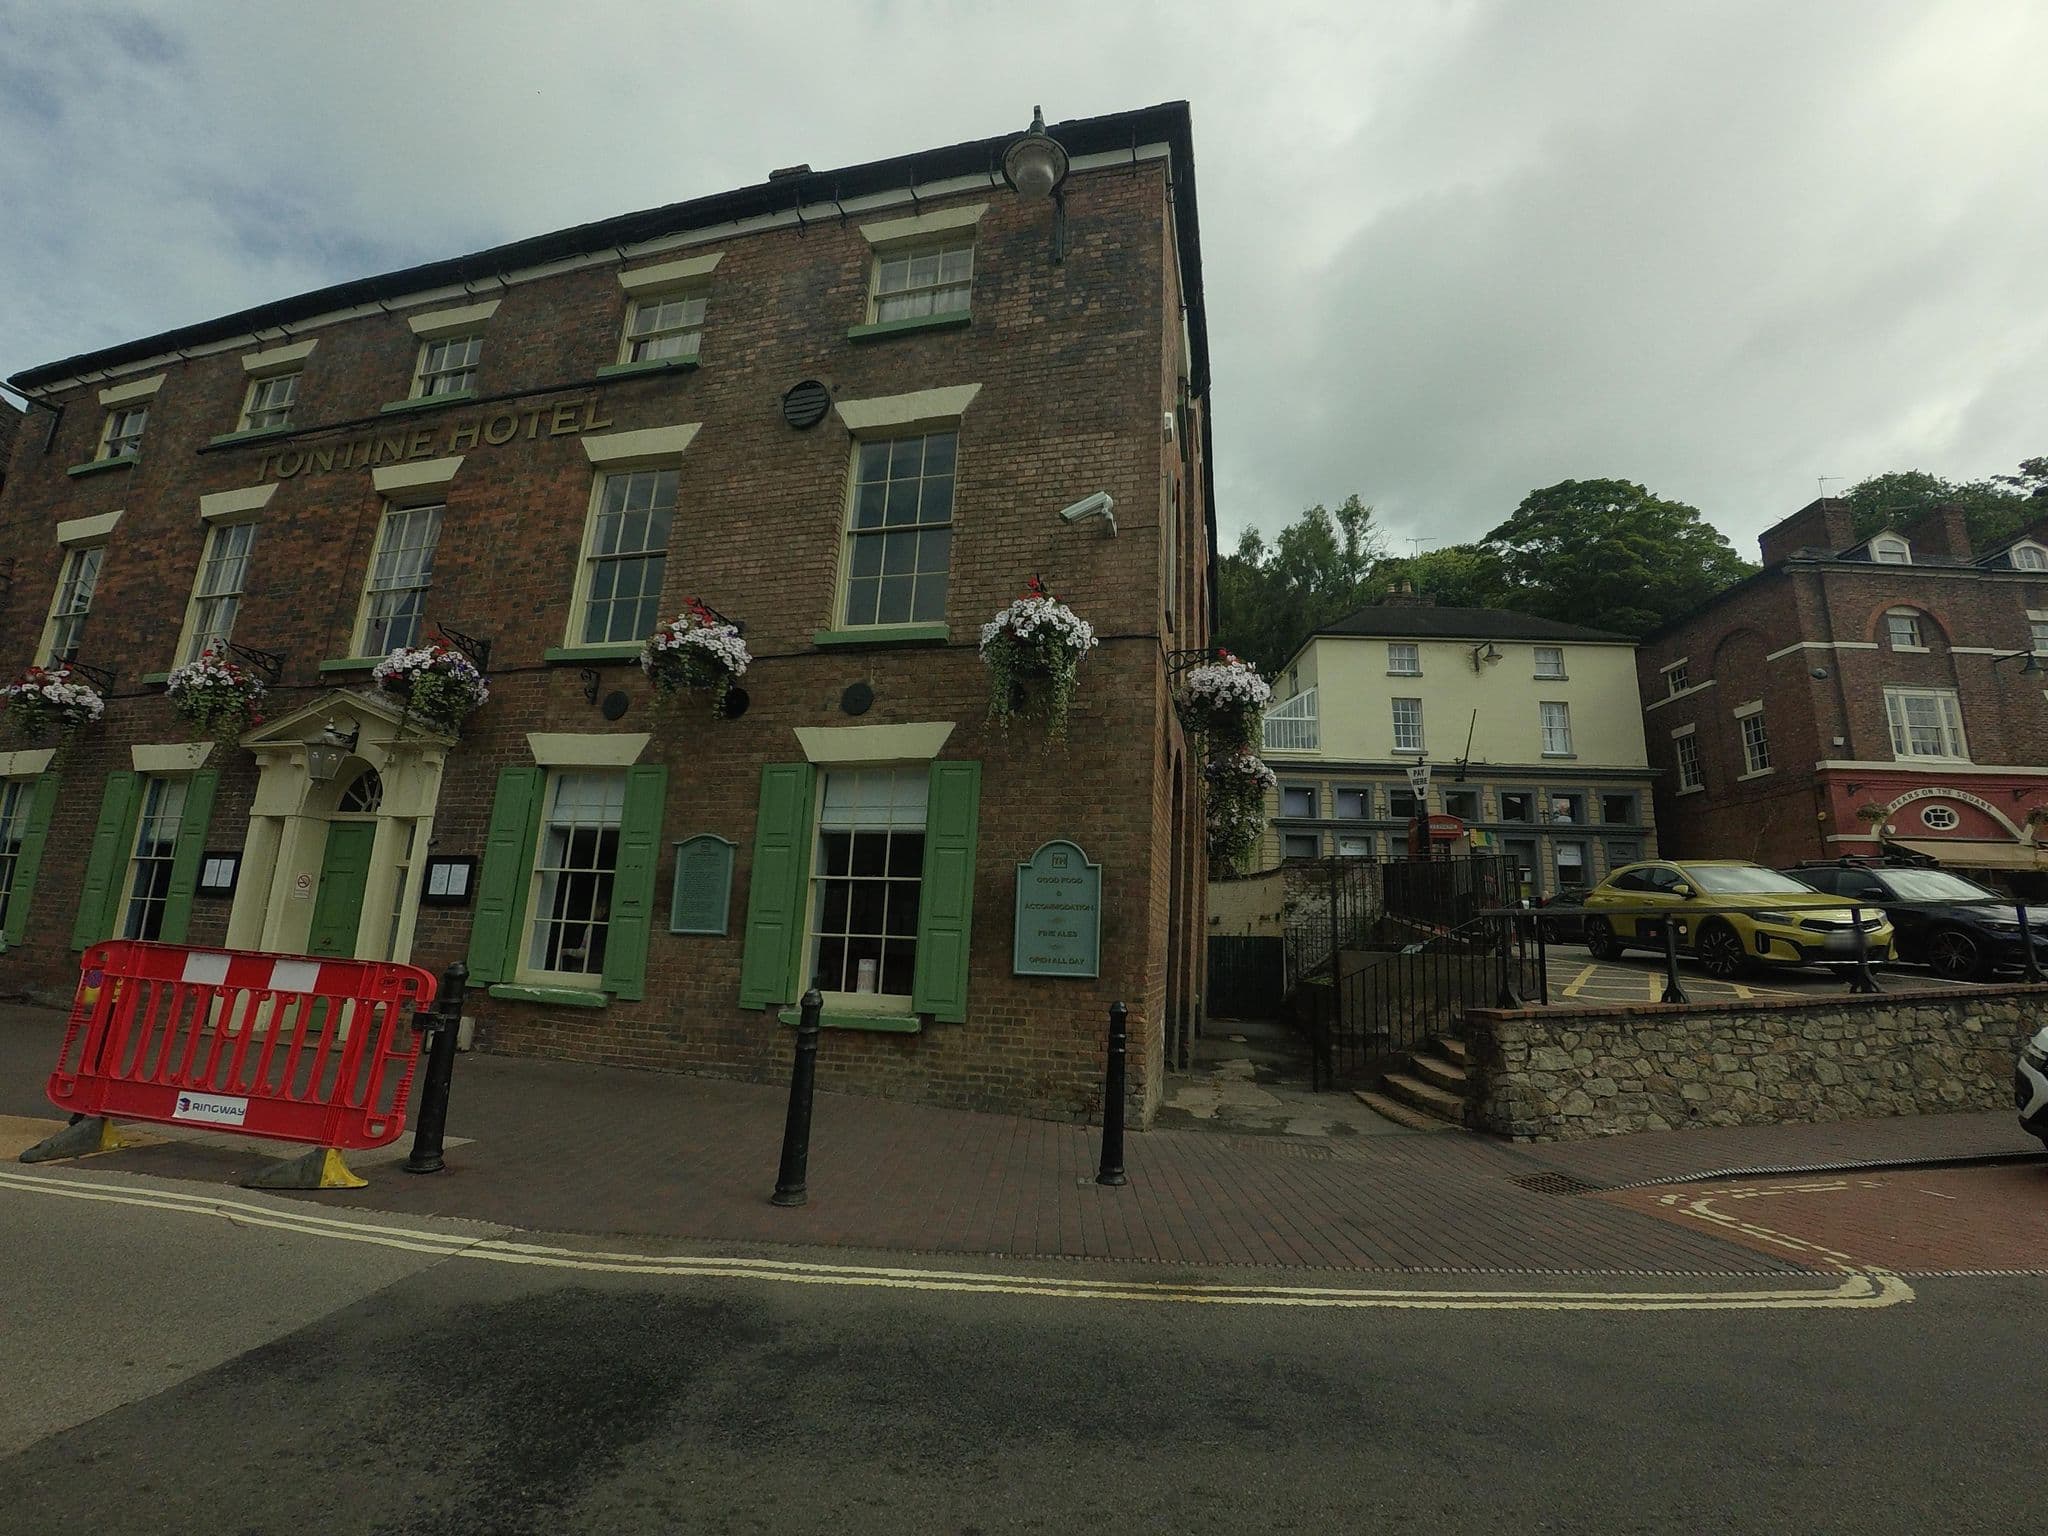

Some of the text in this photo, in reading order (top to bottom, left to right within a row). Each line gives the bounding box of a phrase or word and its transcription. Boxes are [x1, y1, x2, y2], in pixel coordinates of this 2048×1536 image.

[254, 396, 614, 483] TONTINE HOTEL
[1413, 768, 1425, 777] PAY
[1412, 777, 1428, 785] HERE
[1936, 788, 1952, 796] THE
[1957, 791, 1992, 811] SQUARE
[1061, 877, 1083, 885] FOOD
[1025, 903, 1096, 912] ACCOMMODATION
[1038, 929, 1078, 938] FINE ALES
[1052, 956, 1067, 965] ALL
[1069, 957, 1085, 965] DAY
[192, 1102, 246, 1116] RINGWAY
